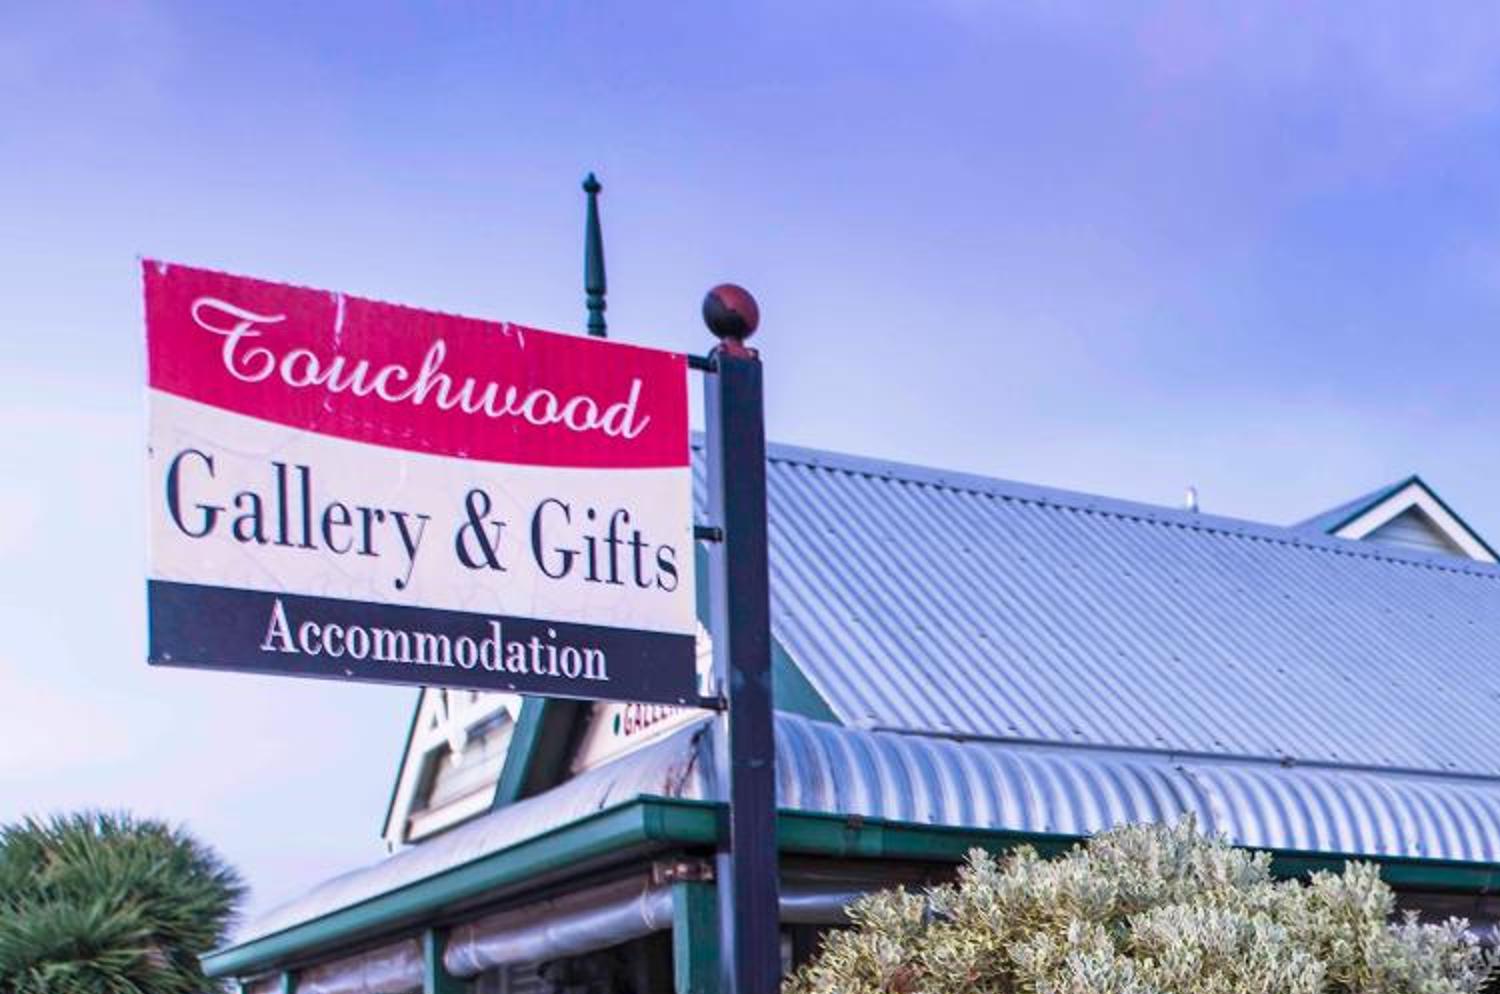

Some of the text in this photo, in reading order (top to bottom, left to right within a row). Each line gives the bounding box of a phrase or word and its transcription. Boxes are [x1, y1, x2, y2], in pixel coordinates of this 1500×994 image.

[190, 297, 650, 439] Touchwood
[166, 449, 679, 592] Gallery & Gifts
[261, 600, 609, 680] Accommodation
